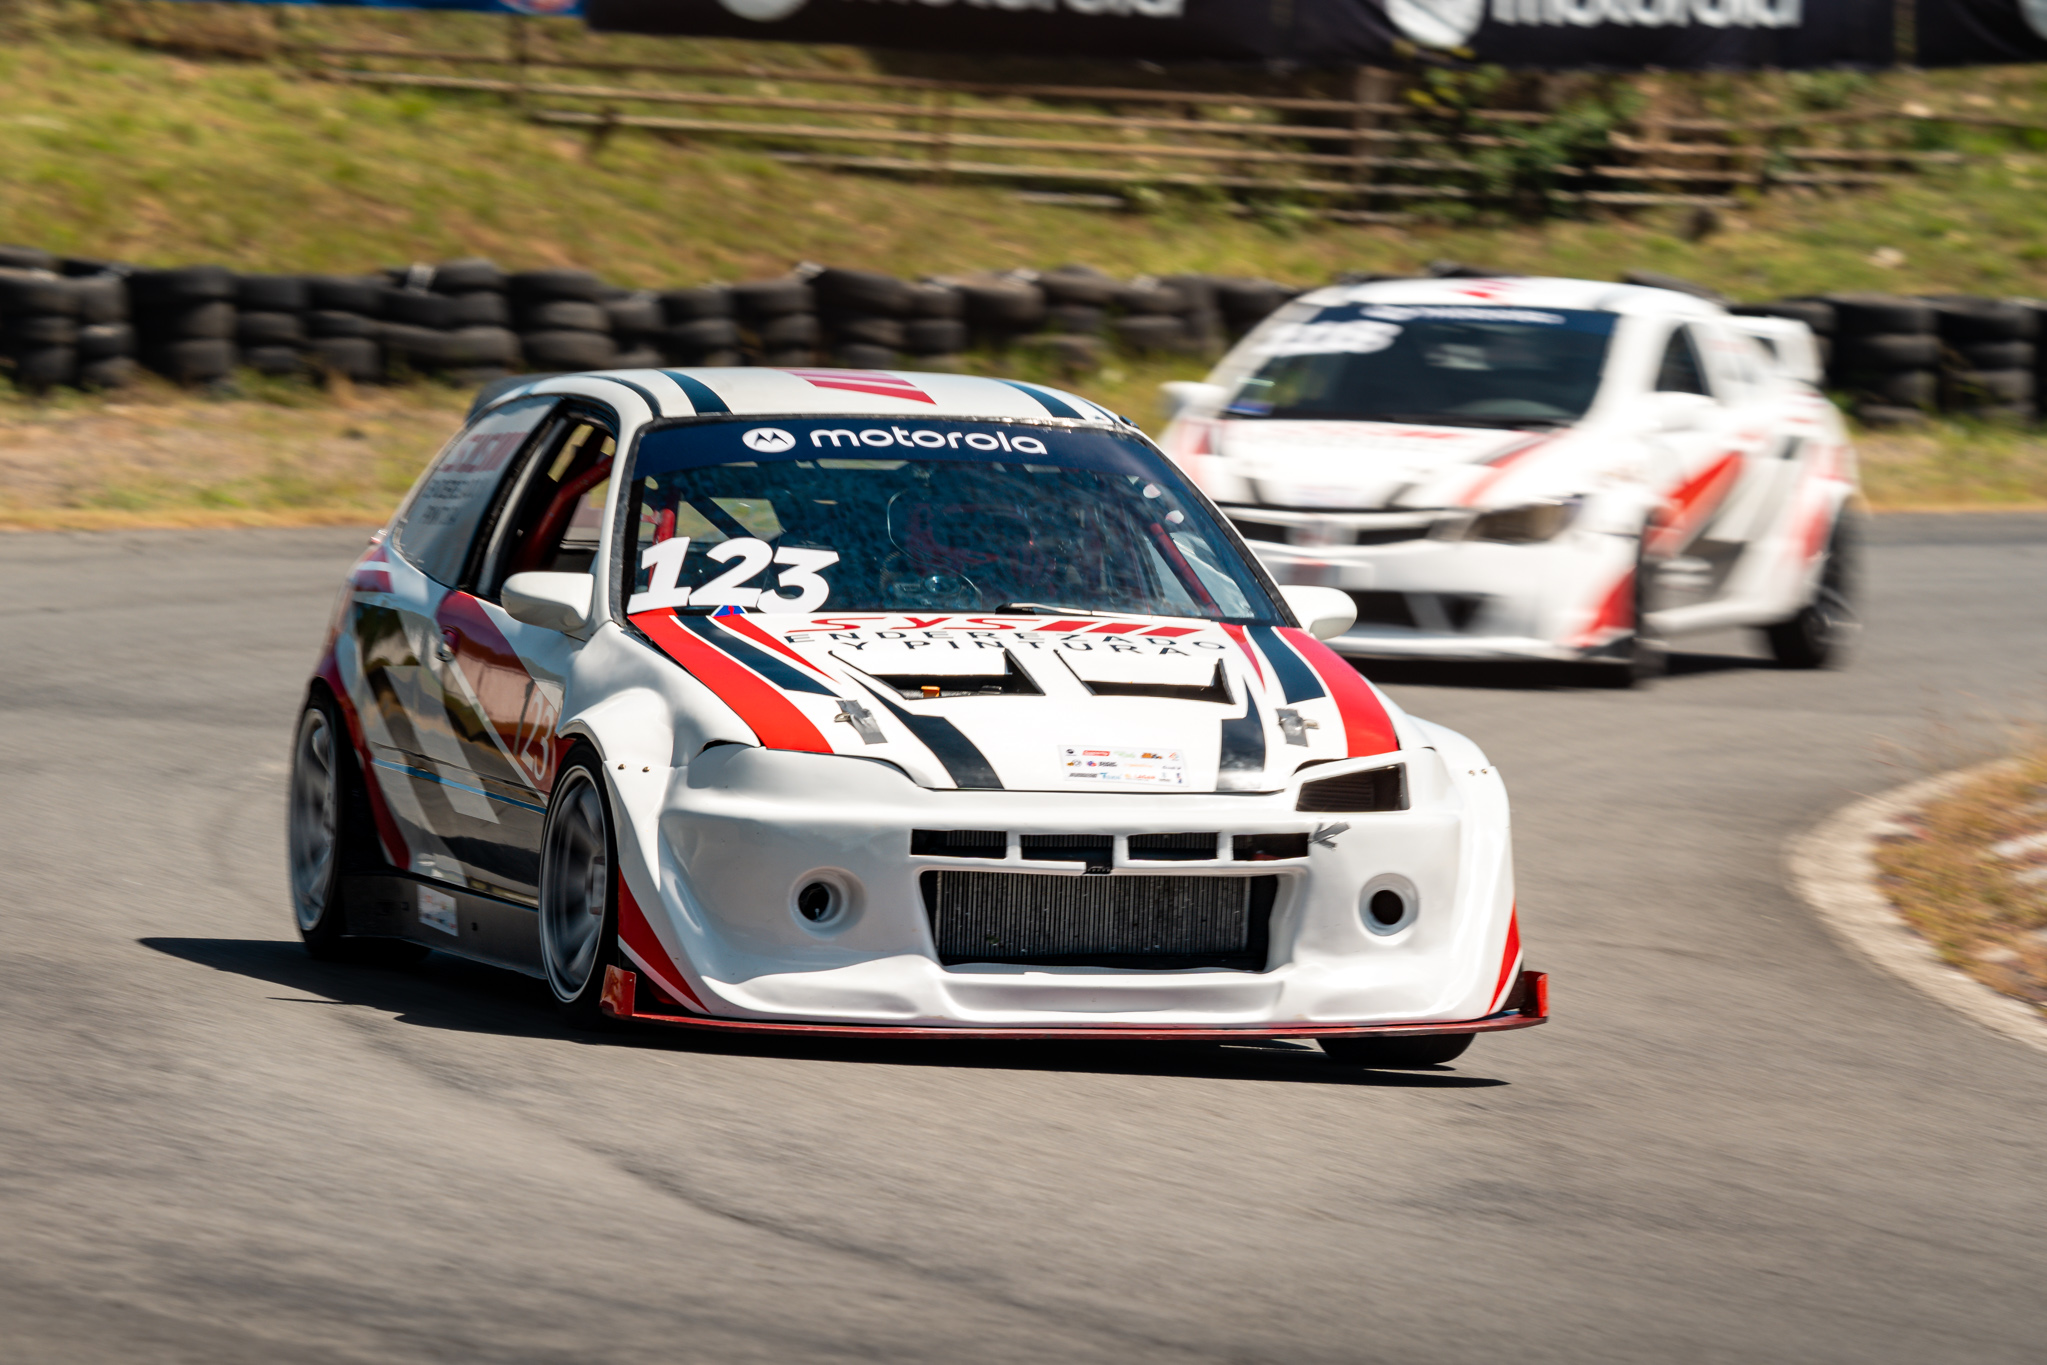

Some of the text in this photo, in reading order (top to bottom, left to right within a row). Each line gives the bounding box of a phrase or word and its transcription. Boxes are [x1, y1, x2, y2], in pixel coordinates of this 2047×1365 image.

[809, 426, 1048, 455] motorola
[627, 536, 840, 614] 123
[786, 616, 1042, 634] SYS
[783, 630, 1226, 650] ENDEREZADO
[842, 640, 1191, 657] Y PINTURA
